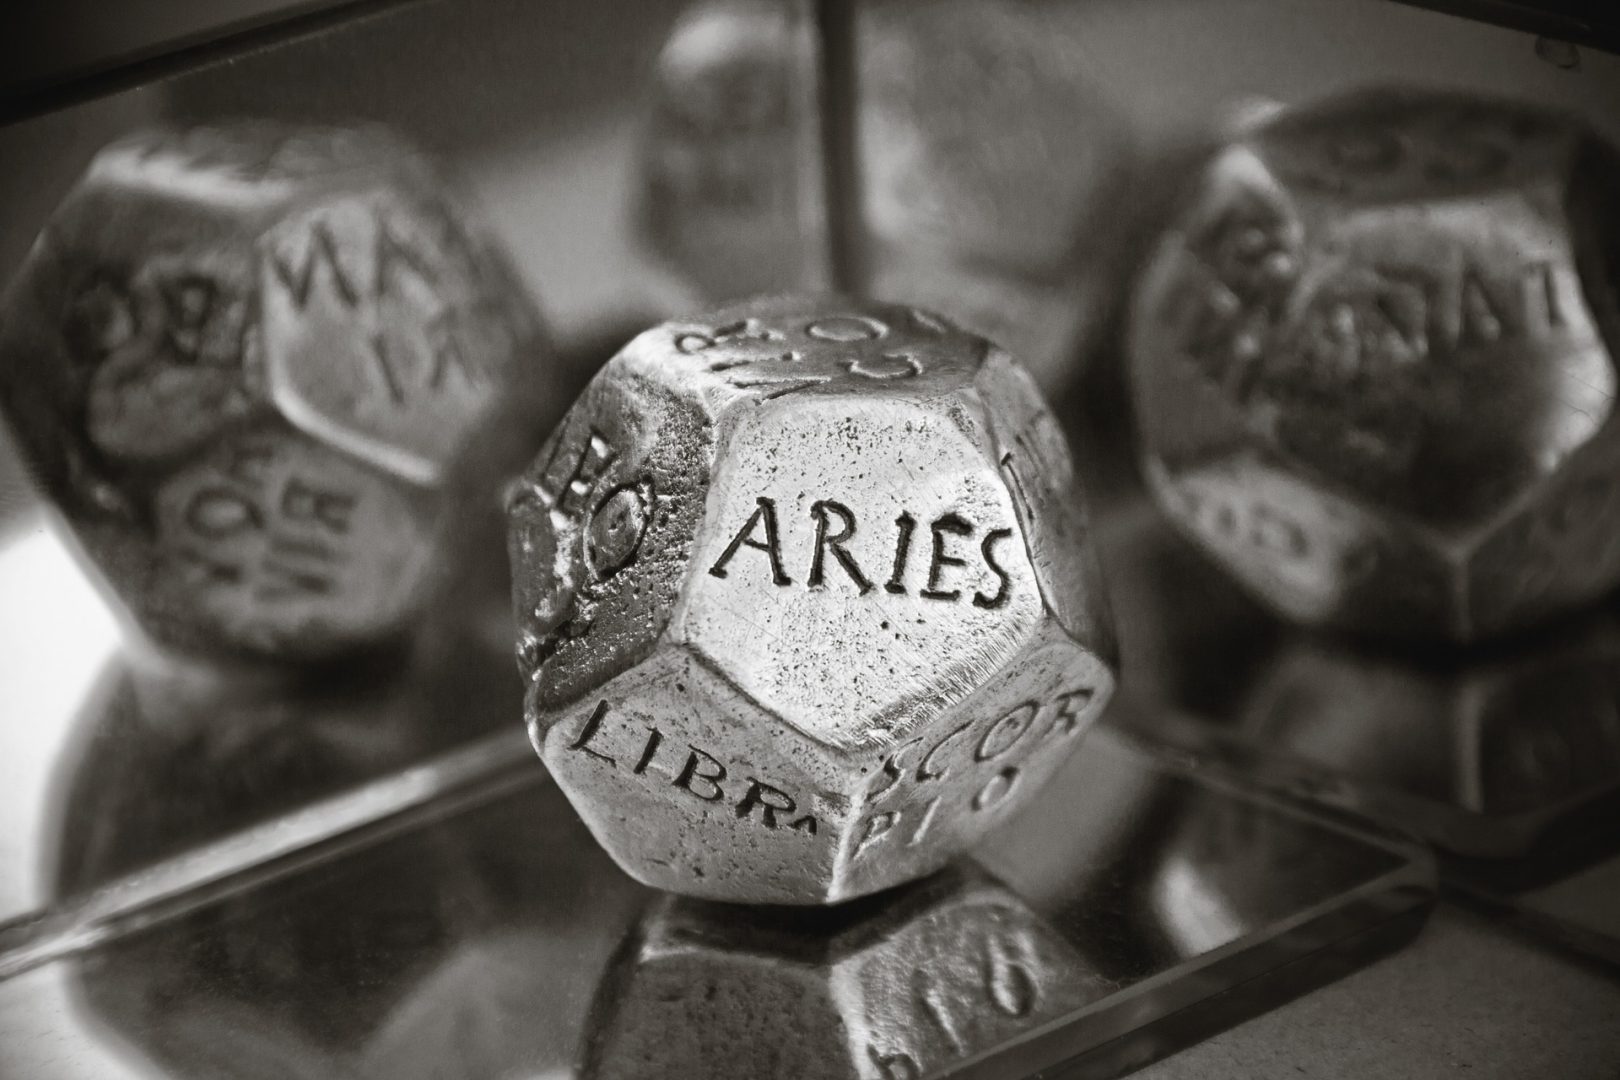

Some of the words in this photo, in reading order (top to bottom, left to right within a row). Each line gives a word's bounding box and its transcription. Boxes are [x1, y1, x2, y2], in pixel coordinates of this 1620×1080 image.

[708, 496, 1014, 610] ARIES
[569, 699, 818, 836] LIBRA
[866, 687, 1095, 801] SCOR
[852, 765, 1020, 861] PIO
